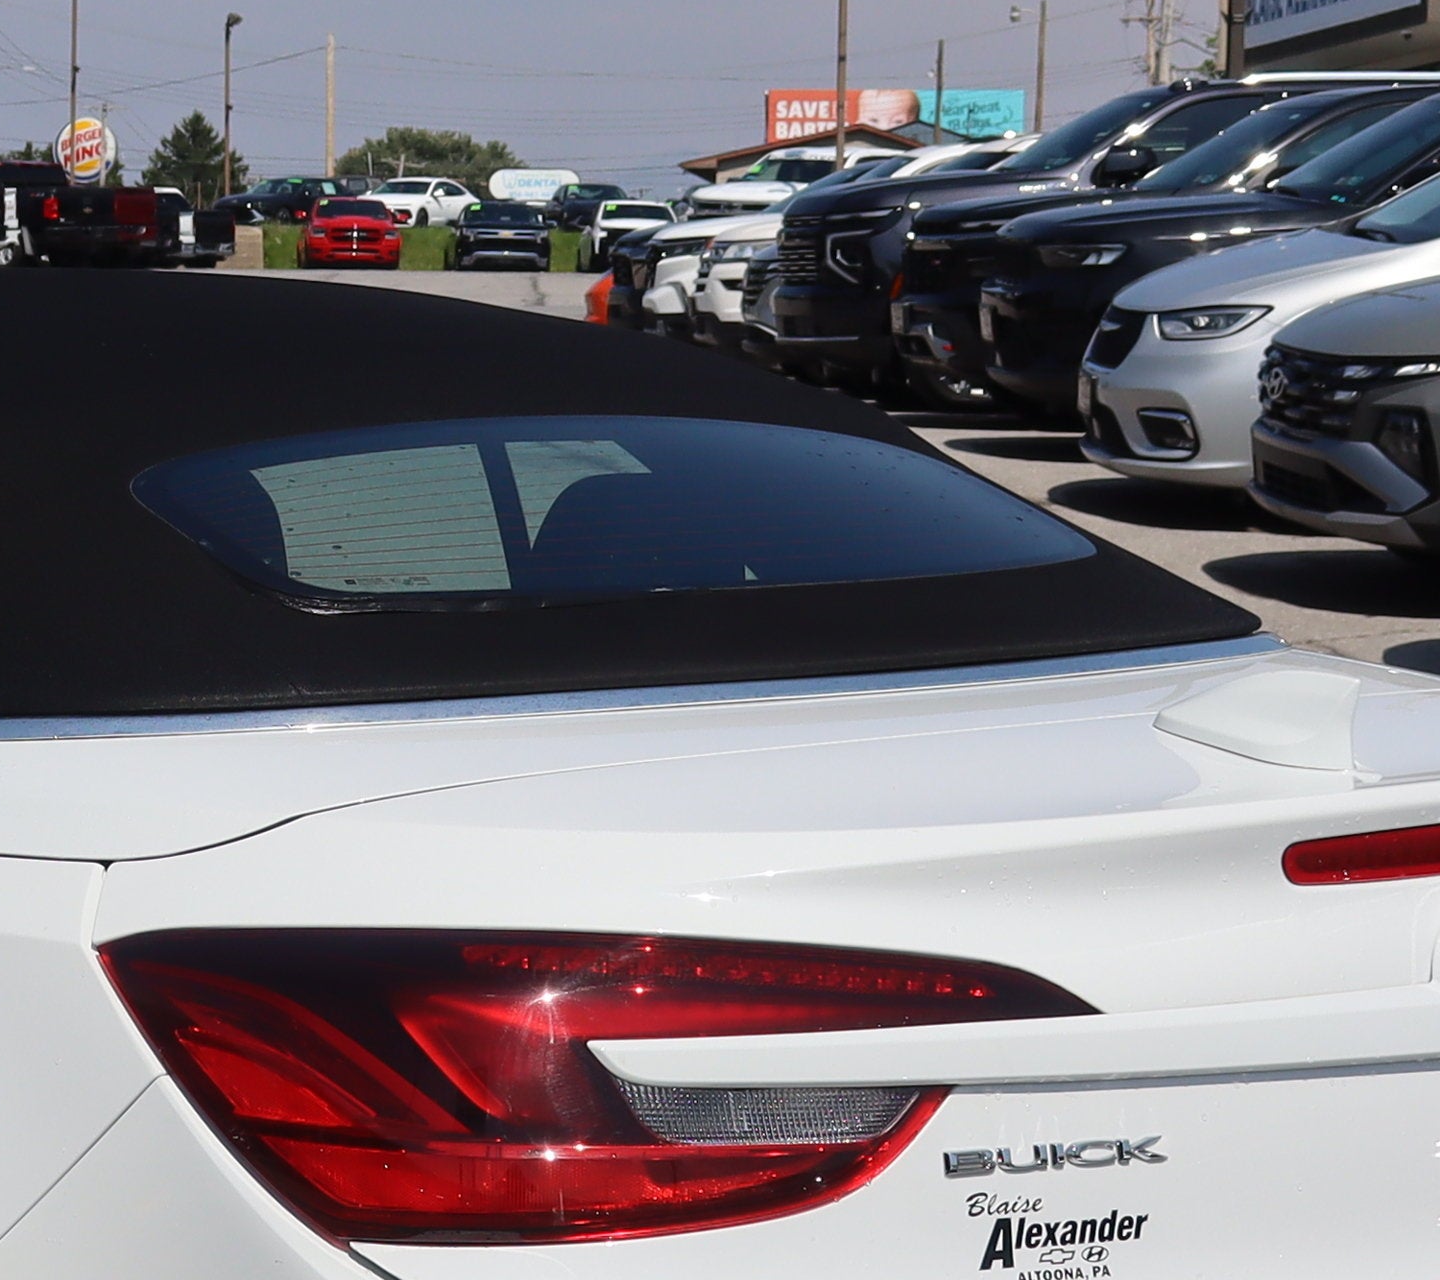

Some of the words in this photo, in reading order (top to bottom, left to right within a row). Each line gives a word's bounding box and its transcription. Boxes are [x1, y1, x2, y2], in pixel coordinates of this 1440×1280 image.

[776, 100, 830, 119] SAVE
[943, 1134, 1168, 1179] BUICK
[965, 1192, 1043, 1217] Blaise
[979, 1209, 1149, 1271] Alexander
[1092, 1264, 1111, 1279] PA
